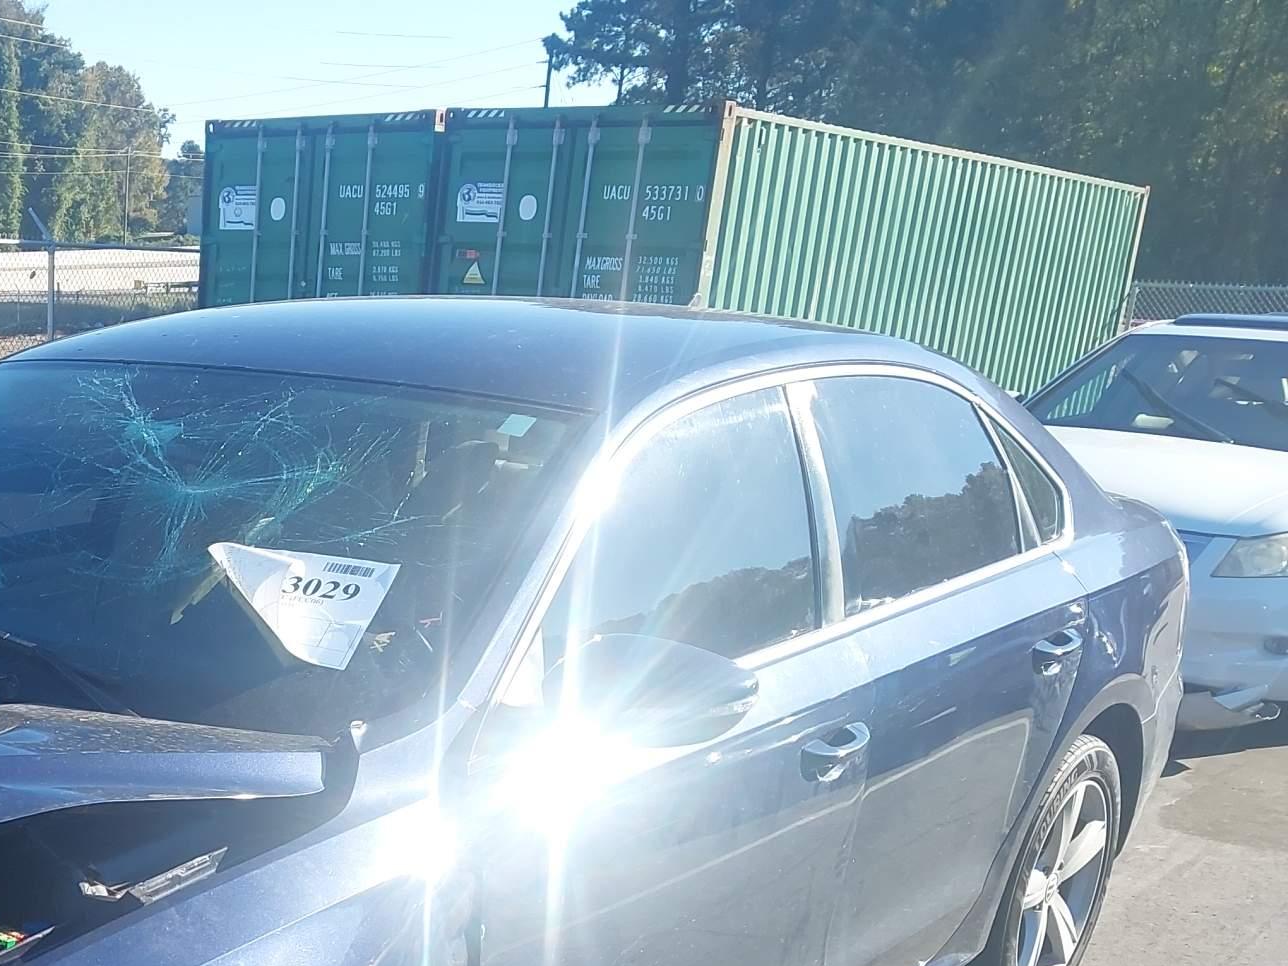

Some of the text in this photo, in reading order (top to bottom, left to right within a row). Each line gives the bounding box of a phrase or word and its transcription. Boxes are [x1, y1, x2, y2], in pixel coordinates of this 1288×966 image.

[339, 183, 425, 199] UACU 524495 9
[603, 184, 704, 201] UACU 533731 0
[374, 201, 397, 216] 45G1
[642, 205, 672, 221] 45G1
[328, 267, 343, 280] TARE
[583, 274, 601, 289] TARE
[282, 576, 361, 601] 3029
[1034, 767, 1079, 852] TOURING
